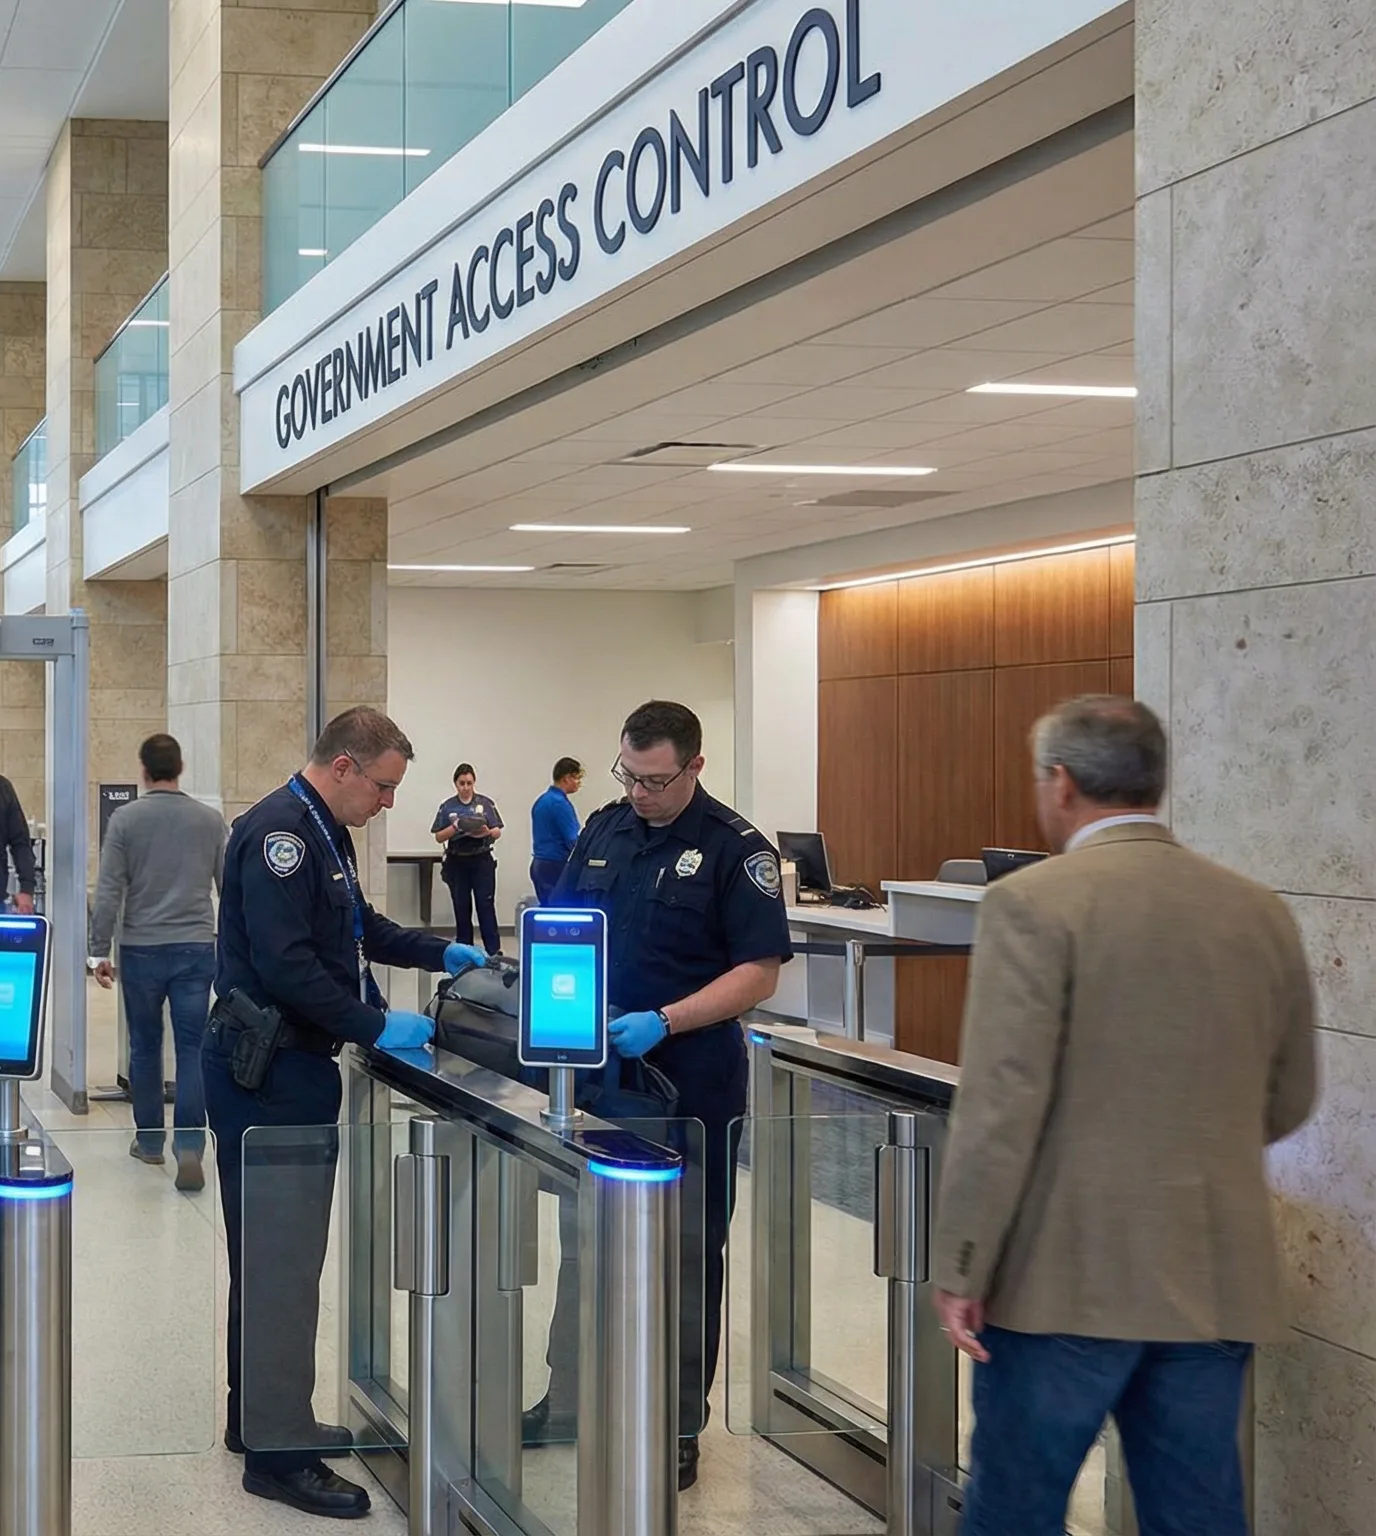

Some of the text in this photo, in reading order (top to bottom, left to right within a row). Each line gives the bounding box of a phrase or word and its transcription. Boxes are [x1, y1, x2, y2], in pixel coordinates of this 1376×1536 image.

[275, 0, 881, 449] GOVERNMENT ACCESS CONTROL
